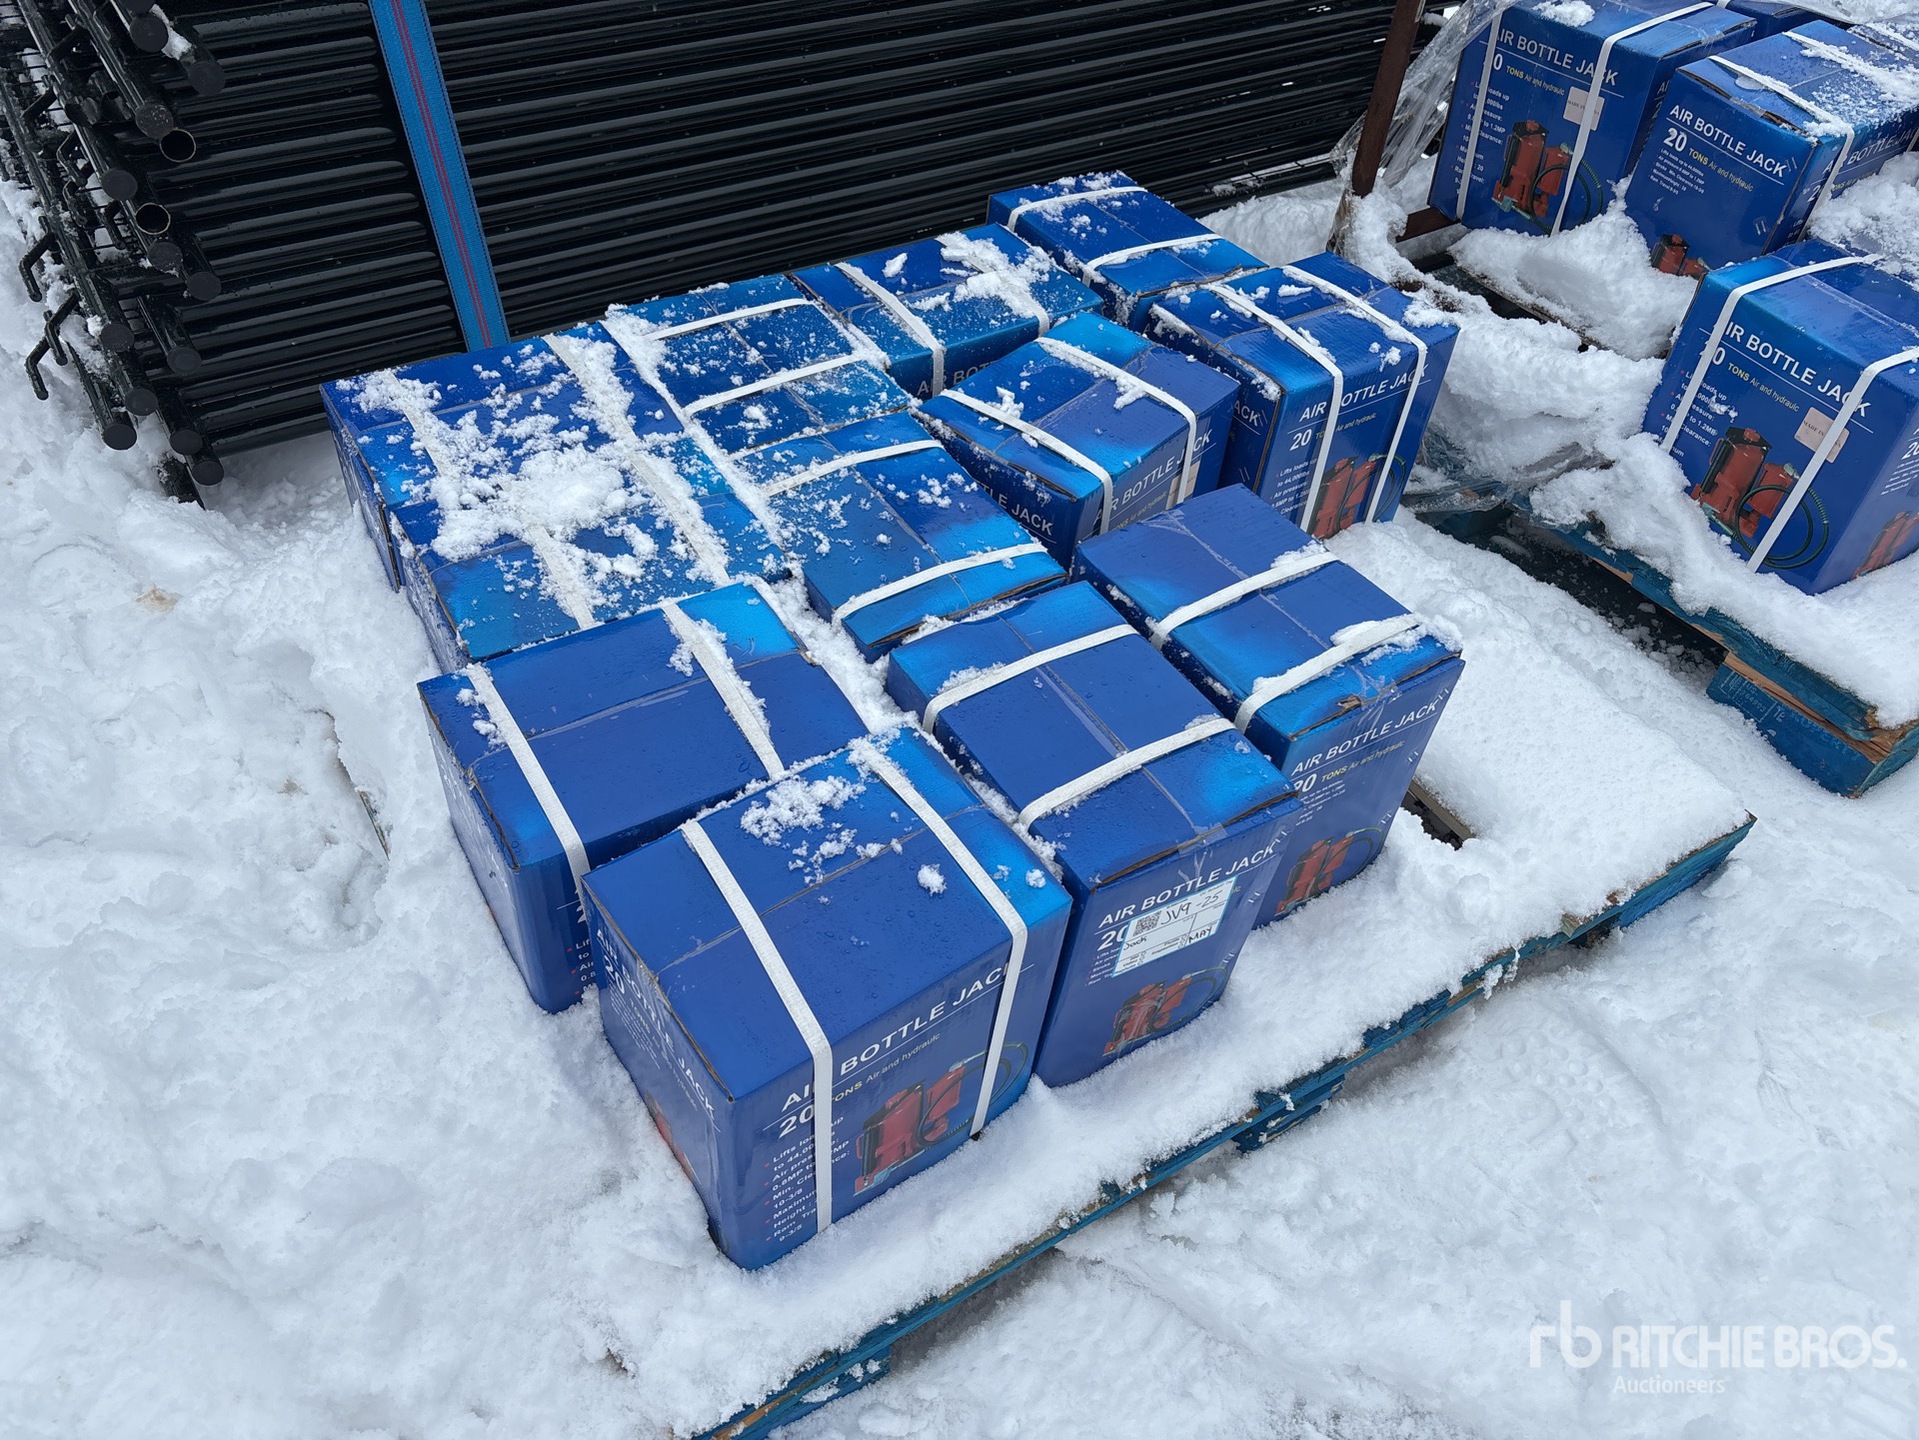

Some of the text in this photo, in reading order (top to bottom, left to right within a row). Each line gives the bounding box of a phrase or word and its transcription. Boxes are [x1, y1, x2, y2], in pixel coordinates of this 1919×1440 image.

[1506, 65, 1525, 79] TONS
[1517, 33, 1575, 69] BOTTLE
[1575, 59, 1619, 87] JAK
[1657, 79, 1670, 95] AI
[1663, 127, 1688, 152] 20
[1688, 147, 1709, 165] TONS
[1708, 160, 1717, 171] Air
[1717, 165, 1729, 179] and
[1669, 104, 1787, 178] AIR BOTTLE JACK
[1725, 321, 1745, 344] IR
[1745, 333, 1817, 387] BOTTLE
[1728, 361, 1750, 382] TONS
[1750, 376, 1760, 389] Air
[1759, 381, 1773, 397] and
[1298, 401, 1328, 422] AIR
[1341, 379, 1389, 407] OTTLE
[1718, 392, 1727, 401] up
[1233, 400, 1259, 427] ACK
[1689, 414, 1697, 424] to
[1289, 428, 1313, 451] 20
[1122, 456, 1175, 505] BOTTLE
[1177, 428, 1213, 465] JCK
[1011, 503, 1054, 536] JACK
[1291, 699, 1438, 777] AIR BOTTLE JACK
[1321, 765, 1348, 782] TONS
[1098, 904, 1137, 929] AIR
[1141, 868, 1223, 910] BOTTLE
[1225, 841, 1276, 875] JACK
[1188, 925, 1213, 944] MAY
[578, 951, 590, 960] to
[580, 970, 597, 981] 0.8
[603, 955, 625, 995] 20
[596, 929, 618, 965] AIR
[621, 964, 675, 1053] BOTTLE
[677, 1057, 716, 1120] JACK
[781, 1080, 815, 1112] AI
[840, 1001, 946, 1076] BOTTLE
[778, 1104, 815, 1139] 20
[832, 1080, 863, 1102] ONS
[865, 1070, 881, 1084] Air
[881, 1058, 900, 1074] and
[773, 1145, 797, 1162] Lifts
[772, 1168, 789, 1183] Air
[772, 1168, 804, 1192] 0.8MP
[773, 1162, 785, 1172] to
[772, 1185, 795, 1201] Min.
[773, 1204, 806, 1230] Height
[773, 1220, 796, 1238] Ram
